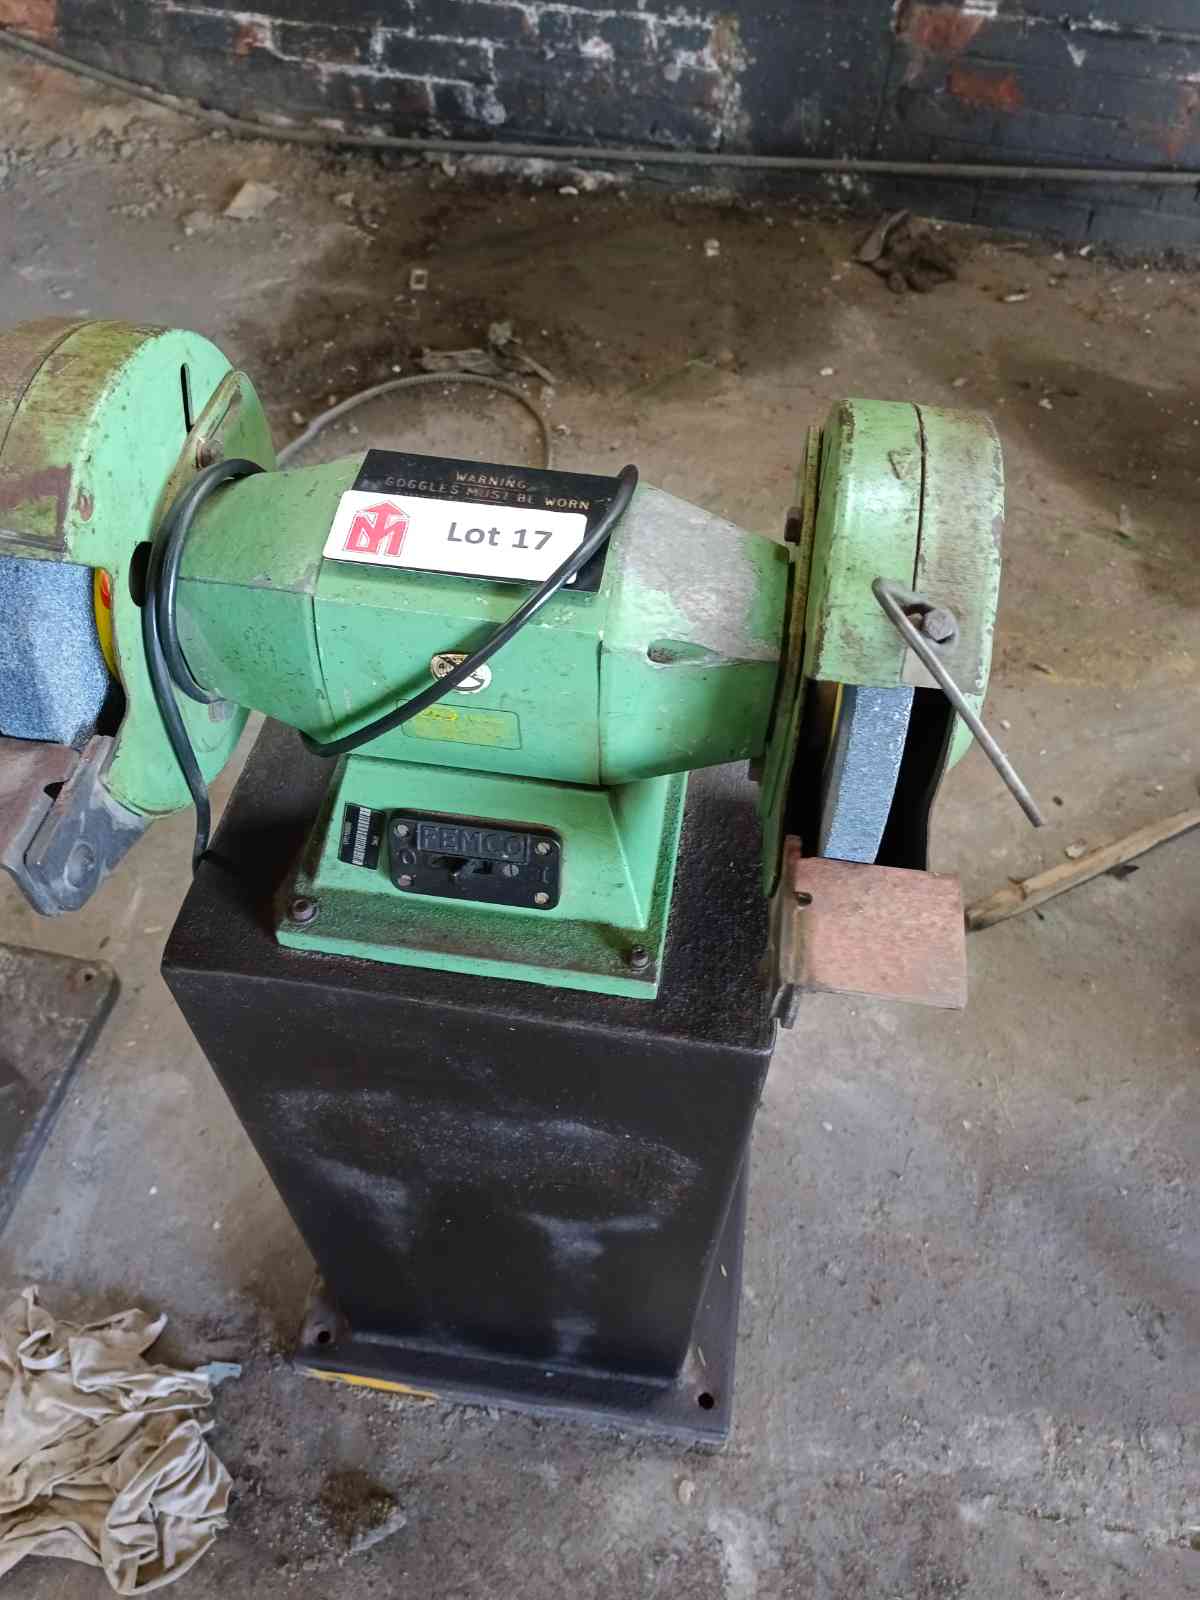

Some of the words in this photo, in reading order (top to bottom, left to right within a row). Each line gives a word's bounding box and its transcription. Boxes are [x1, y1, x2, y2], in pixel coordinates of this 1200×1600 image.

[384, 476, 460, 495] GOGGLES
[466, 486, 509, 501] MUST
[544, 496, 591, 510] WORN
[455, 471, 529, 489] WARNING
[447, 522, 501, 547] Lot
[512, 528, 553, 551] 17
